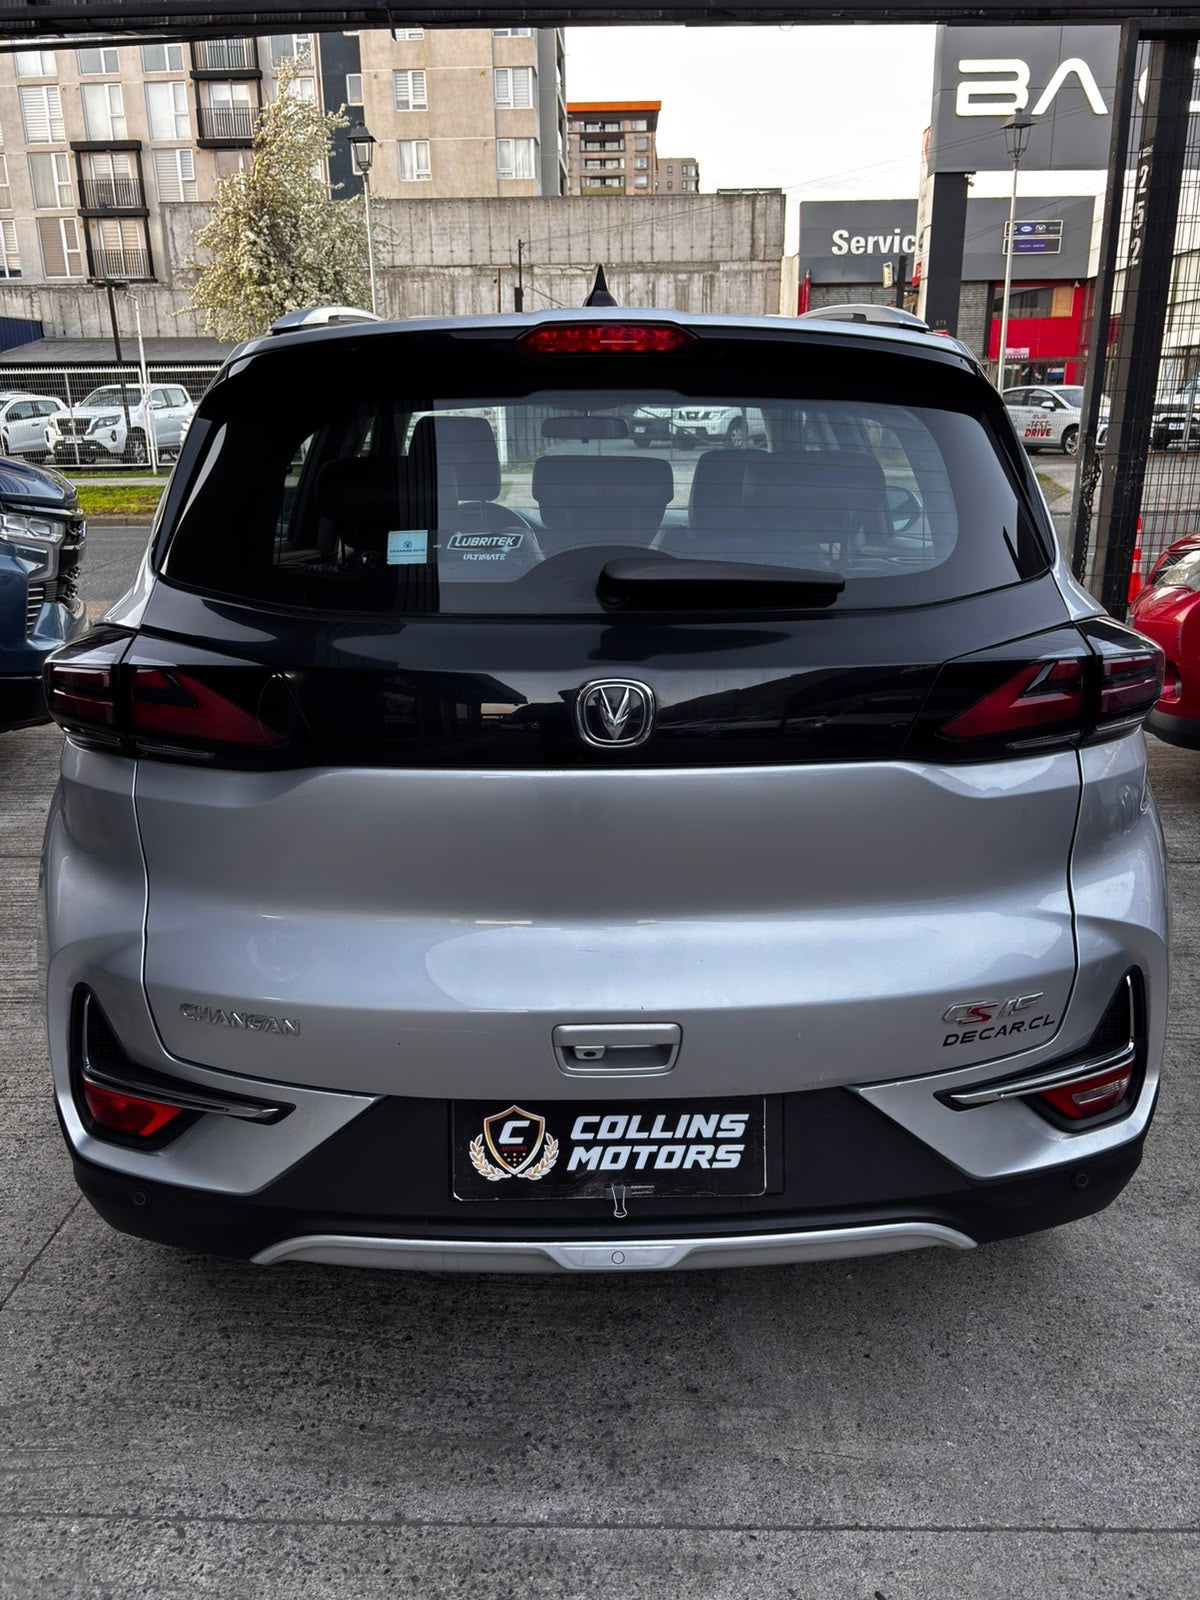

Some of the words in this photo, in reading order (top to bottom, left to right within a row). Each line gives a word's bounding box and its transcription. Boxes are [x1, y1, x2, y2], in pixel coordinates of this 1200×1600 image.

[1024, 428, 1052, 438] DRIVE
[454, 534, 516, 547] LUBRITEK
[463, 553, 507, 561] ULTIMATE
[179, 1002, 301, 1036] CHANGAN
[942, 1014, 1055, 1047] DECAR.CL
[570, 1113, 749, 1140] COLLINS
[566, 1144, 745, 1171] MOTORS
